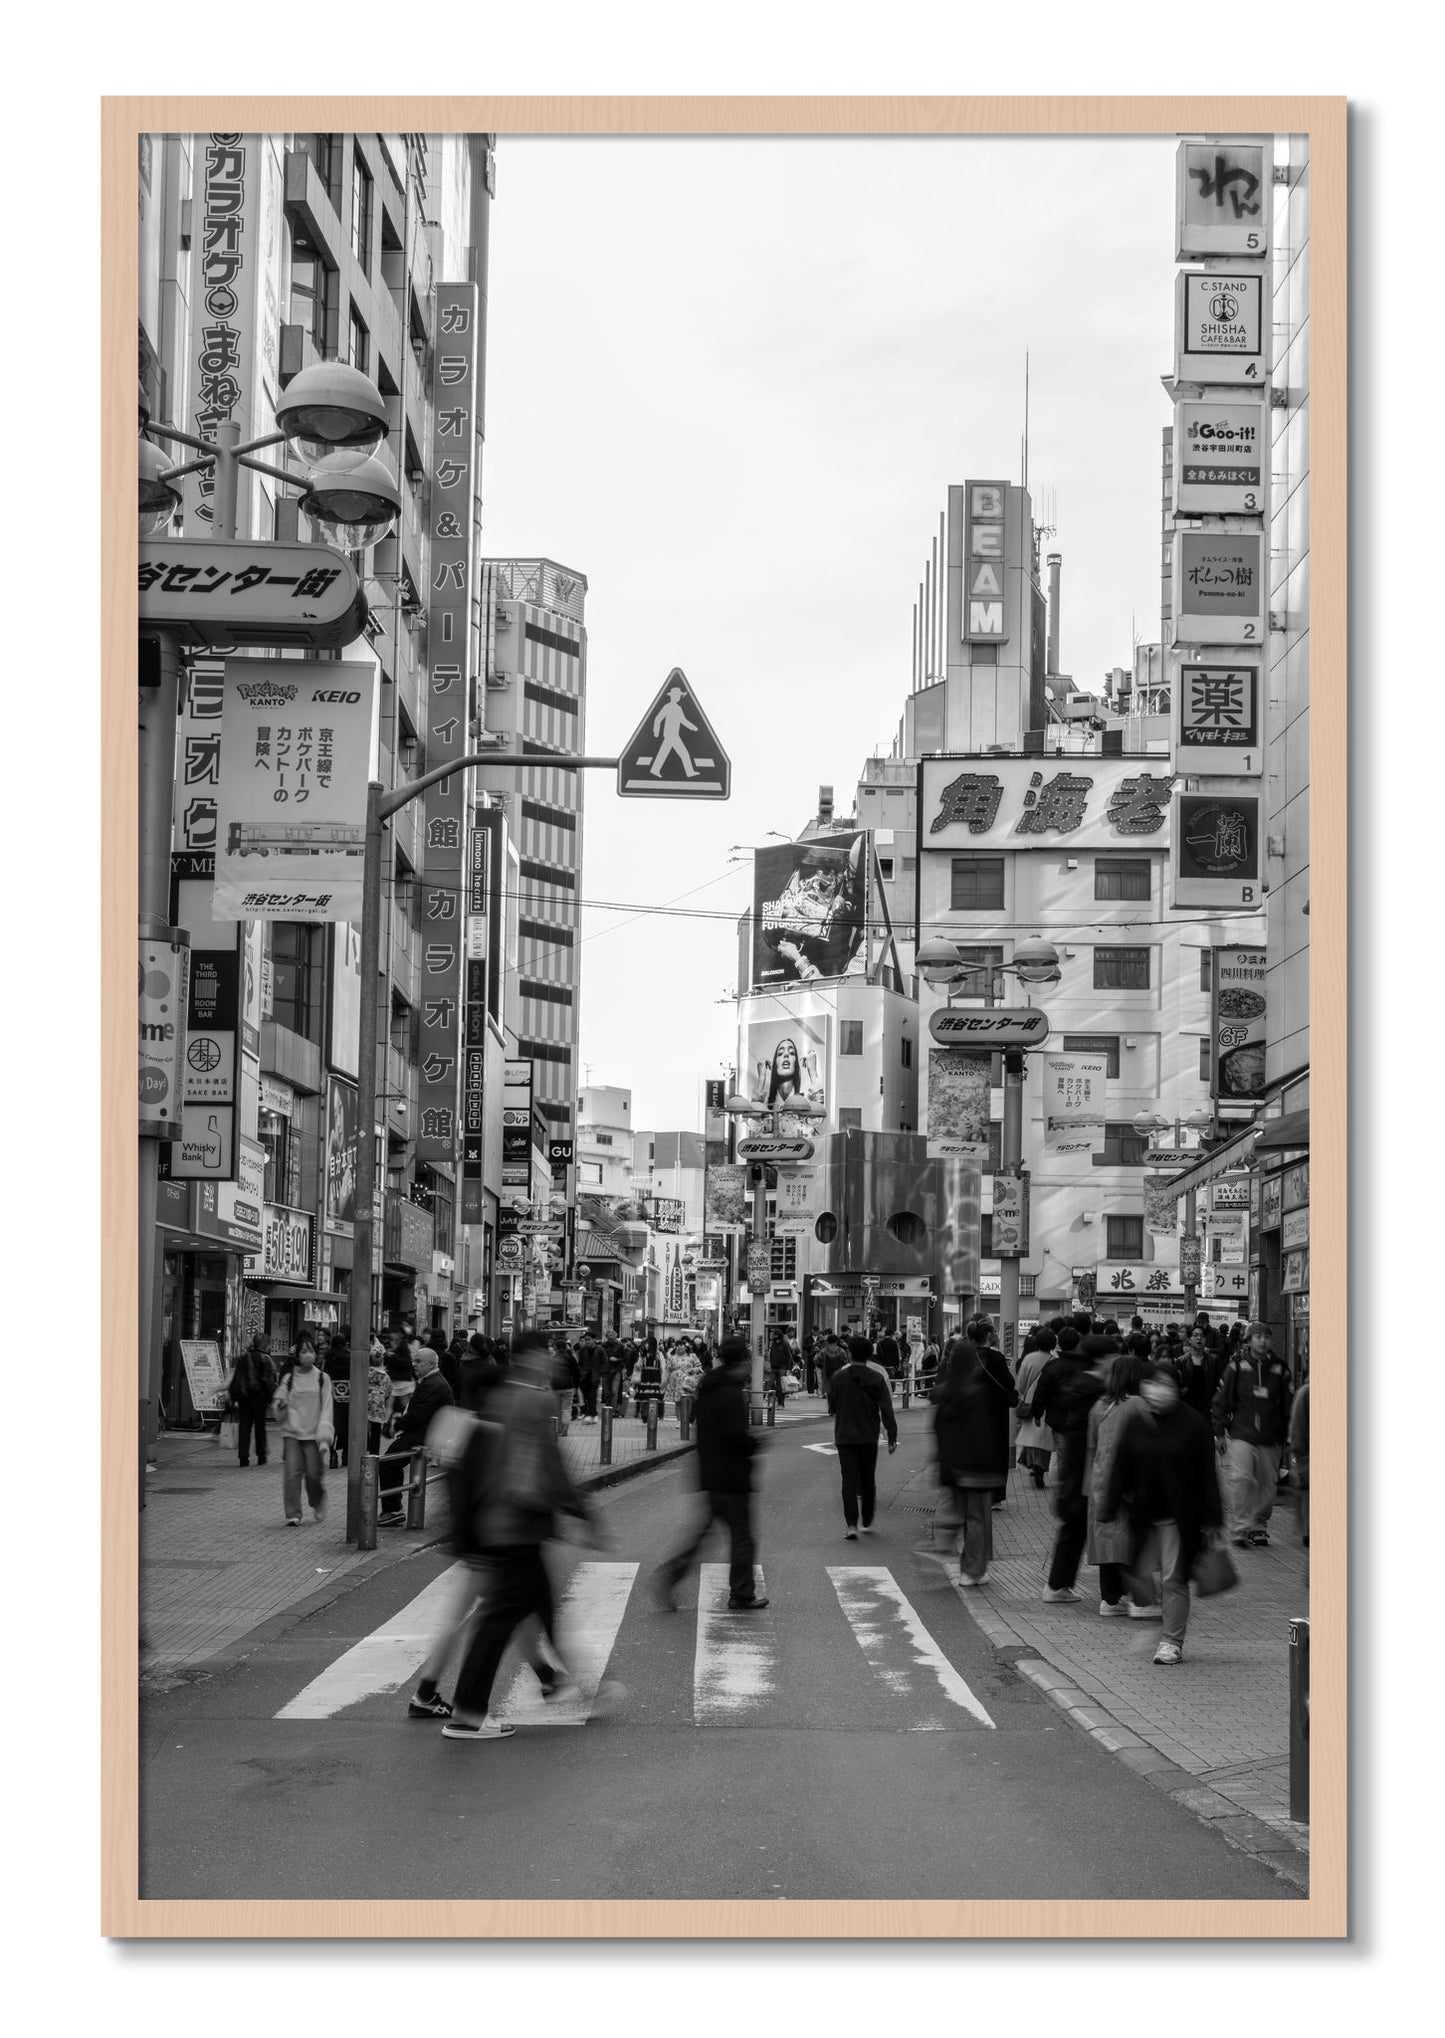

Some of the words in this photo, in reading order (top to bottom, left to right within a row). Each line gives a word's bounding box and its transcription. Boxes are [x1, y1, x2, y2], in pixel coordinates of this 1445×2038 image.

[203, 144, 247, 286] カラオケ
[1247, 232, 1259, 250] 5
[1200, 281, 1248, 292] C.STAND
[1200, 323, 1248, 335] SHISHA
[1200, 334, 1248, 344] CAFE&BAR
[1245, 362, 1259, 380] 4
[1199, 423, 1256, 440] Goo-it!
[1192, 443, 1253, 454] 渋谷宇田川町店
[1187, 469, 1258, 482] 全身もみほぐし
[1244, 492, 1258, 509] 3
[970, 485, 1003, 634] BEAM
[1188, 566, 1255, 586] ポムの樹
[1198, 589, 1246, 599] Pomme-no-ki
[1243, 623, 1256, 640] 2
[250, 698, 286, 706] KANTO
[311, 690, 362, 704] KEIO
[1191, 673, 1244, 726] 薬
[1184, 728, 1249, 743] マツモトキヨシ
[253, 725, 272, 771] 冒険へ
[272, 726, 292, 803] カントーの
[316, 727, 335, 789] 京王線で
[1243, 756, 1252, 771] 1
[929, 772, 1174, 834] 角海老
[1186, 811, 1248, 862] 一蘭
[473, 833, 483, 870] kimono
[242, 893, 333, 907] 渋谷センター街
[473, 875, 483, 910] hearts
[1242, 887, 1254, 903] B
[195, 970, 218, 978] THIRD
[199, 963, 214, 971] THE
[195, 999, 217, 1007] ROOM
[198, 1010, 213, 1018] BAR
[936, 1017, 1042, 1031] 渋谷センター街
[1219, 1026, 1248, 1047] 6F
[146, 1077, 166, 1092] Day!
[182, 1142, 217, 1155] Whisky
[551, 1146, 572, 1158] GU
[741, 1142, 806, 1154] 渋谷センター街
[181, 1153, 203, 1162] Bank
[672, 1267, 682, 1311] BEER
